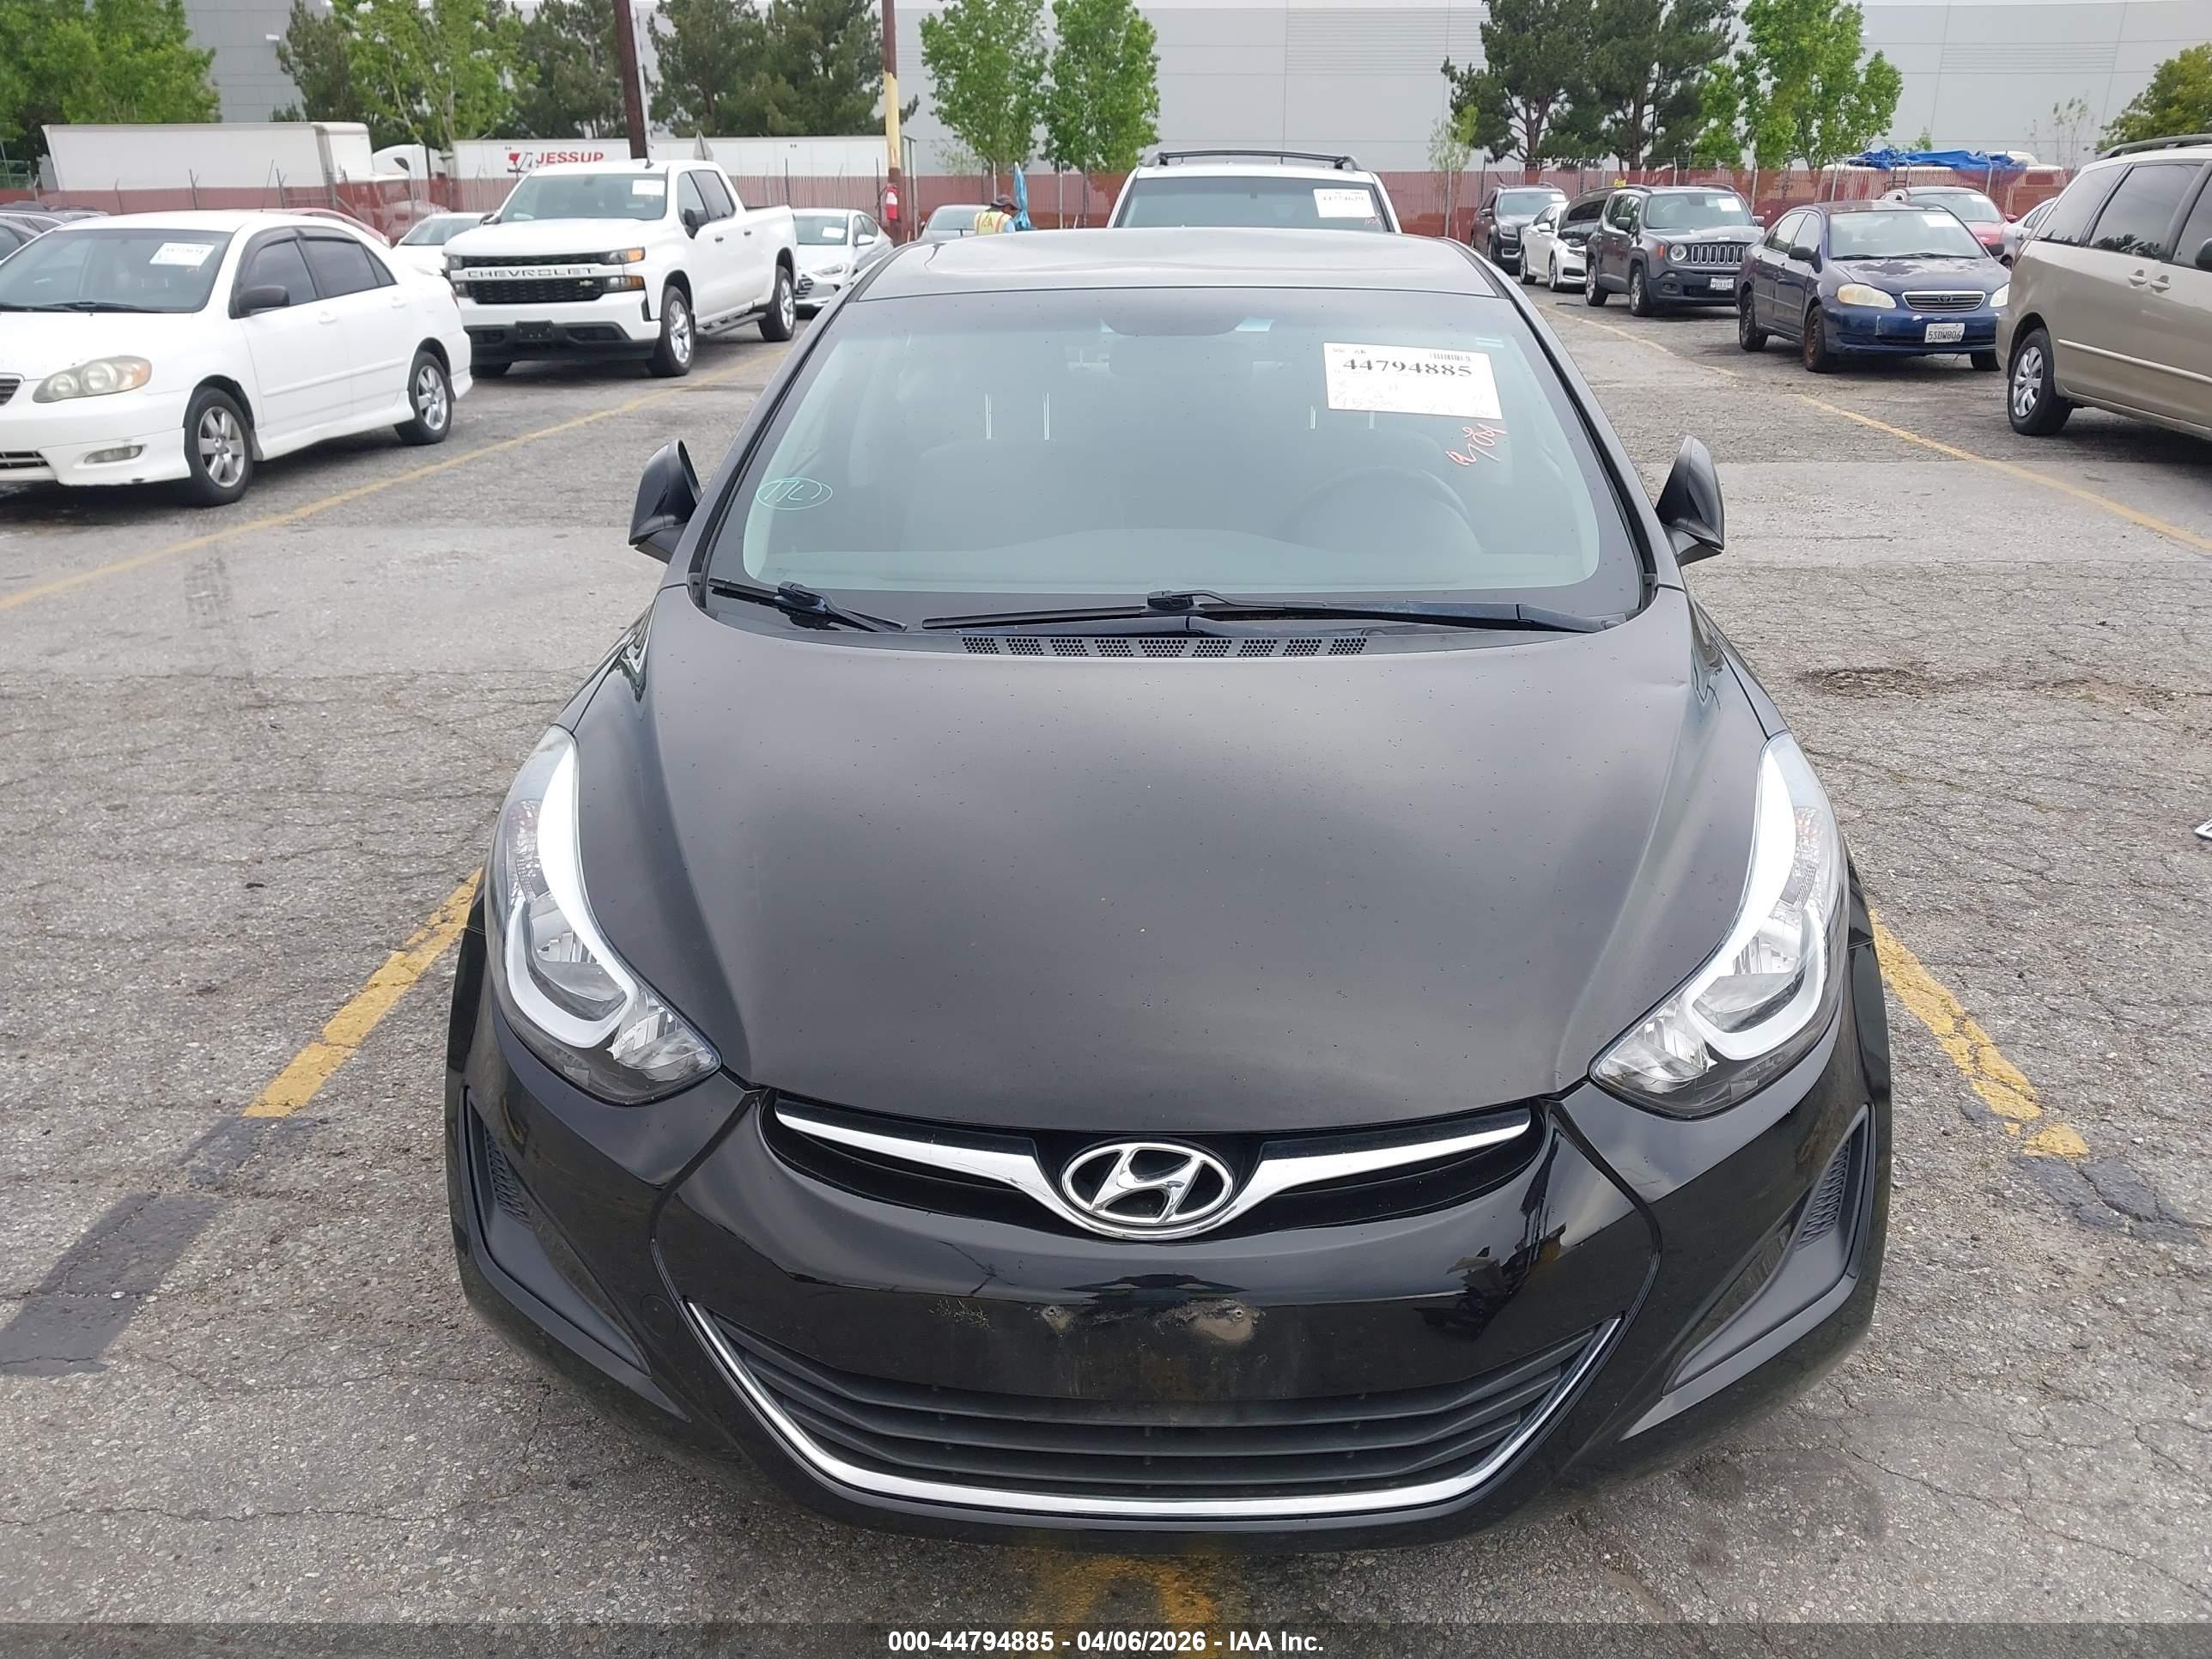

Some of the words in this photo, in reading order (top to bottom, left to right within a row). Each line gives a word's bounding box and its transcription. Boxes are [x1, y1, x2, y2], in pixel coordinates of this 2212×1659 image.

[536, 152, 605, 164] JESSUP
[467, 267, 595, 278] CHEVROLET
[1343, 359, 1473, 376] 44794885
